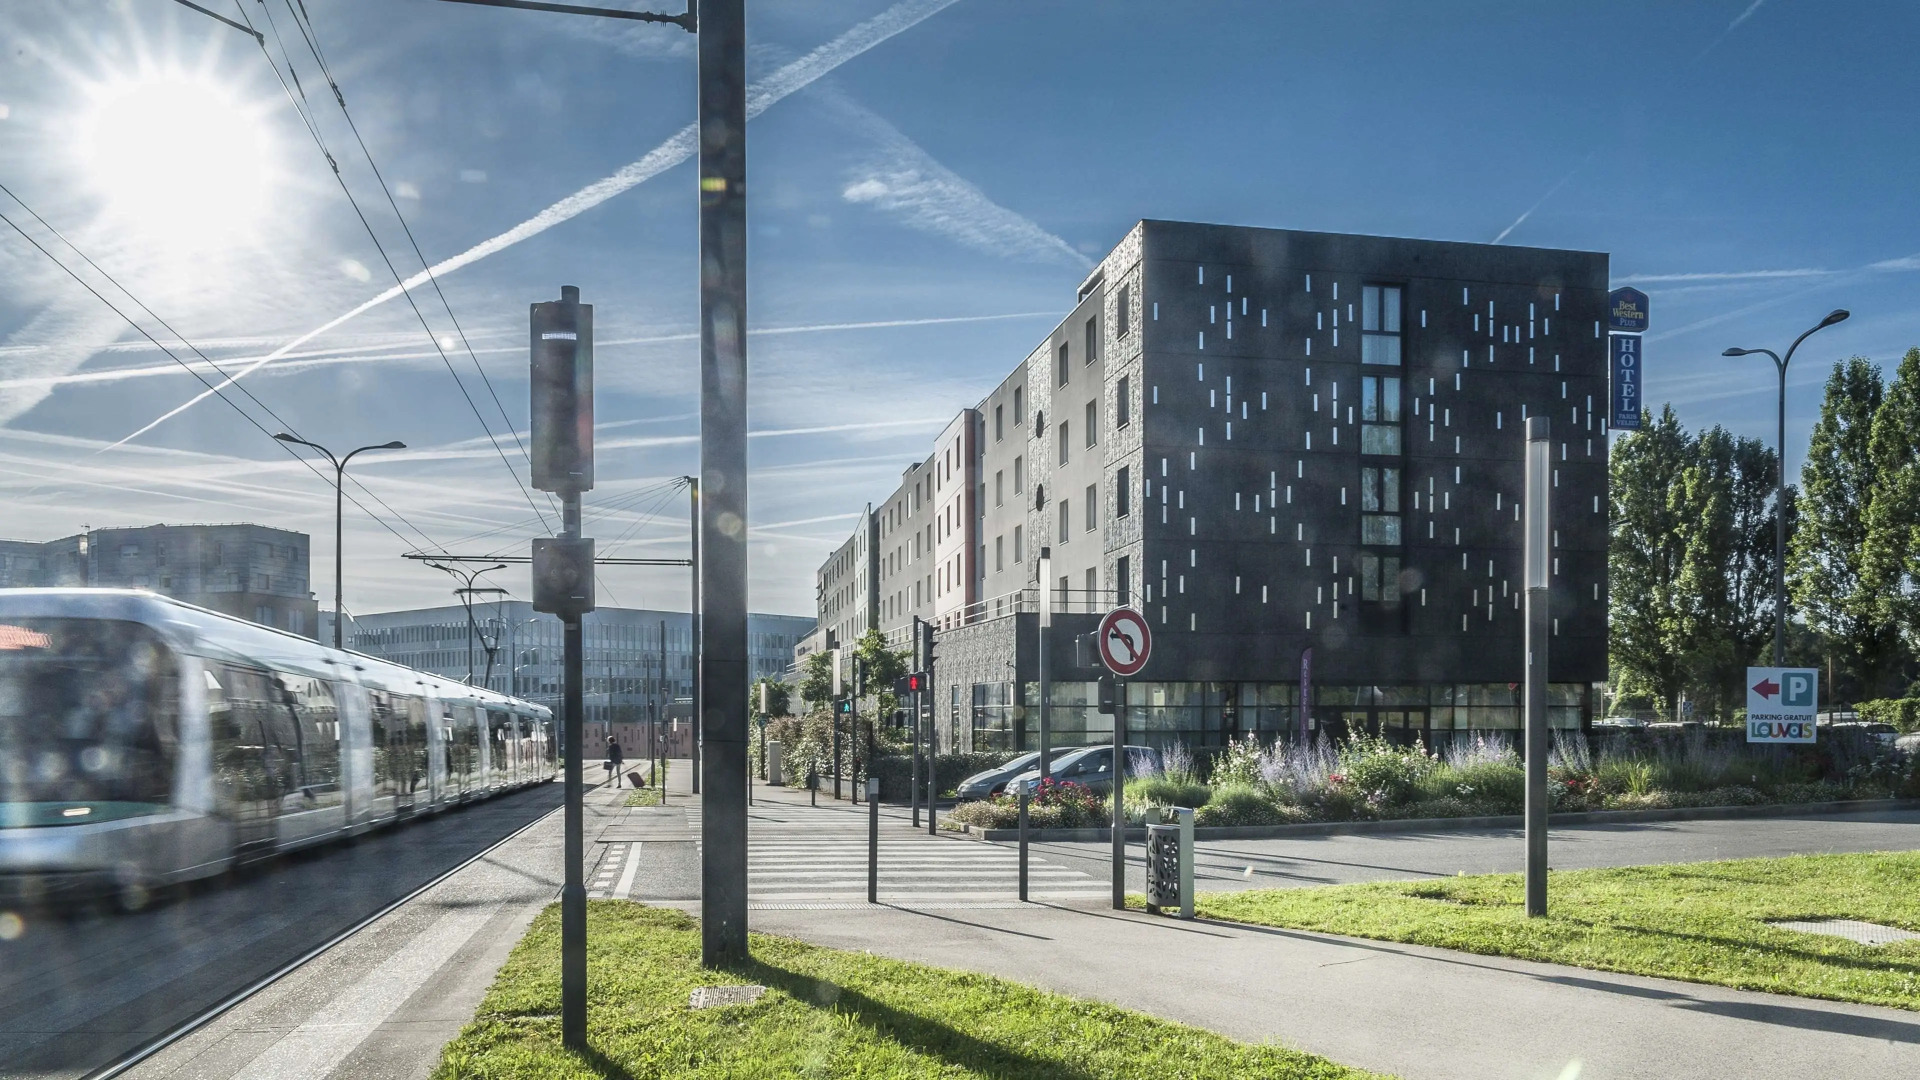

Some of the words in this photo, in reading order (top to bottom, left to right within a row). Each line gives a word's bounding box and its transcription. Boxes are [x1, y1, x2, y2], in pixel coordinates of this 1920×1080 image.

[1612, 308, 1644, 319] Western
[1619, 301, 1636, 311] Best
[1620, 338, 1635, 412] HOTEL
[1789, 677, 1807, 702] P
